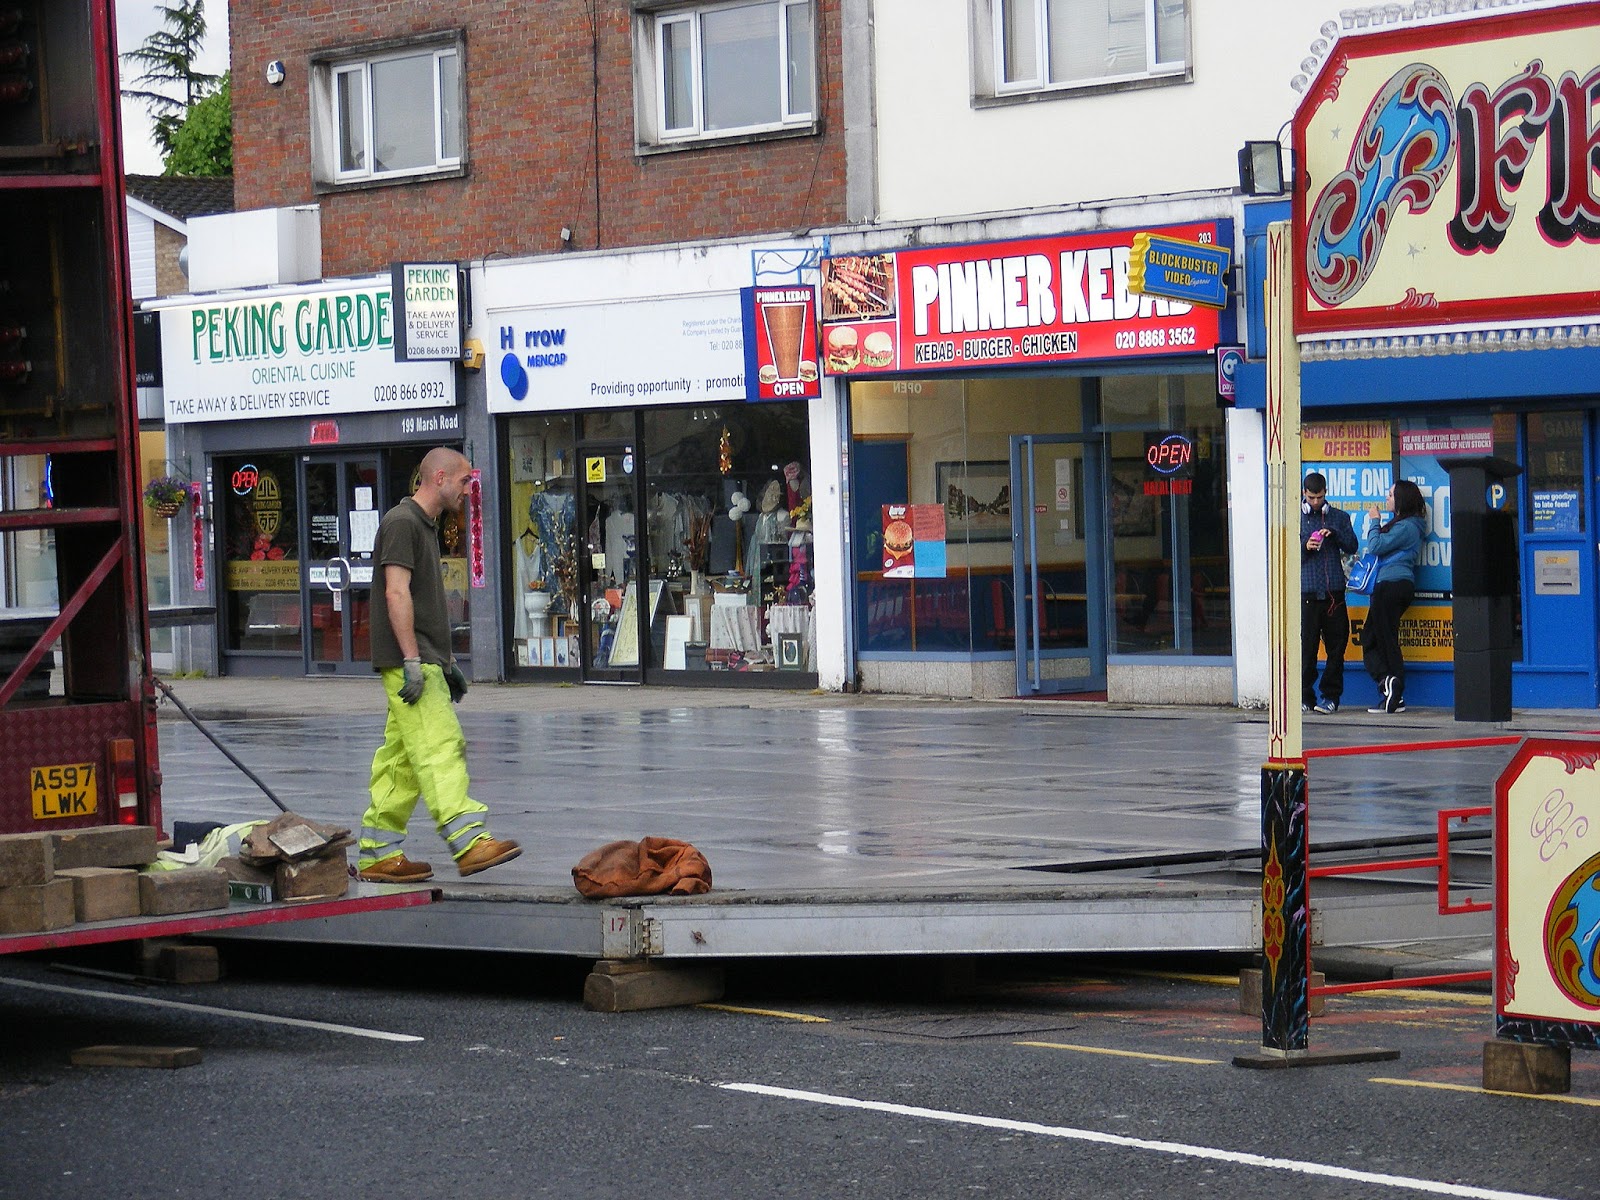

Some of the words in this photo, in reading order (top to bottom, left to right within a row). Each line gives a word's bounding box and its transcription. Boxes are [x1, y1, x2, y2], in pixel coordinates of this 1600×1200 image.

[1199, 232, 1211, 243] 203
[1149, 250, 1218, 276] BLOCKBUSTER
[408, 269, 450, 283] PEKING
[1164, 270, 1191, 286] VIDEO
[405, 287, 454, 301] GARDEN
[757, 291, 785, 303] PINNER
[786, 290, 810, 302] KEBAB
[912, 254, 1057, 337] PINNER
[1060, 245, 1194, 325] KEB
[408, 311, 428, 319] TAKE
[430, 310, 456, 319] AWAY
[192, 301, 285, 364] PEKING
[296, 291, 394, 354] GARDE
[409, 320, 415, 329] &
[417, 320, 455, 329] DELIVERY
[416, 330, 448, 339] SERVICE
[1116, 332, 1136, 350] 020
[1138, 330, 1165, 348] 8868
[1168, 327, 1195, 345] 3562
[408, 346, 426, 356] 0208
[427, 346, 441, 355] 866
[442, 346, 458, 355] 8932
[722, 340, 733, 350] 020
[914, 340, 954, 363] KEBAB
[964, 337, 1012, 361] BURGER
[1022, 332, 1078, 355] CHICKEN
[527, 353, 567, 367] MENCAP
[252, 363, 306, 385] ORIENTAL
[310, 361, 356, 381] CUISINE
[374, 385, 397, 402] 0208
[400, 383, 418, 400] 866
[420, 381, 444, 398] 8932
[591, 379, 634, 396] Providing
[637, 378, 691, 399] opportunity
[706, 374, 747, 392] promoti
[773, 382, 805, 396] OPEN
[170, 399, 195, 416] TAKE
[197, 397, 228, 413] AWAY
[231, 397, 238, 411] &
[239, 393, 287, 411] DELIVERY
[289, 390, 330, 407] SERVICE
[402, 418, 414, 433] 199
[416, 416, 436, 431] Marsh
[439, 414, 459, 430] Road
[1304, 425, 1344, 439] SPRING
[1347, 424, 1388, 439] HOLIDAY
[1411, 435, 1421, 443] ARE
[1422, 434, 1449, 442] EMPTYING
[1450, 433, 1460, 441] OUR
[1461, 433, 1491, 441] WAREHOUSE
[1324, 441, 1371, 457] OFFERS
[1403, 443, 1413, 451] FOR
[1426, 442, 1450, 450] ARRIVAL
[1451, 441, 1458, 449] OF
[1459, 441, 1470, 449] NEW
[1471, 440, 1492, 448] STOCK!
[1147, 443, 1192, 465] OPEN
[232, 471, 258, 488] OPEN
[1361, 468, 1389, 497] ON!
[1417, 476, 1425, 485] TO
[1551, 493, 1577, 501] goodbye
[1554, 500, 1570, 508] fees!
[1419, 619, 1441, 628] CREDIT
[1412, 629, 1432, 637] TRADE
[1433, 629, 1440, 637] IN
[33, 766, 94, 791] A597
[42, 791, 87, 816] LWK
[611, 917, 625, 932] 17
